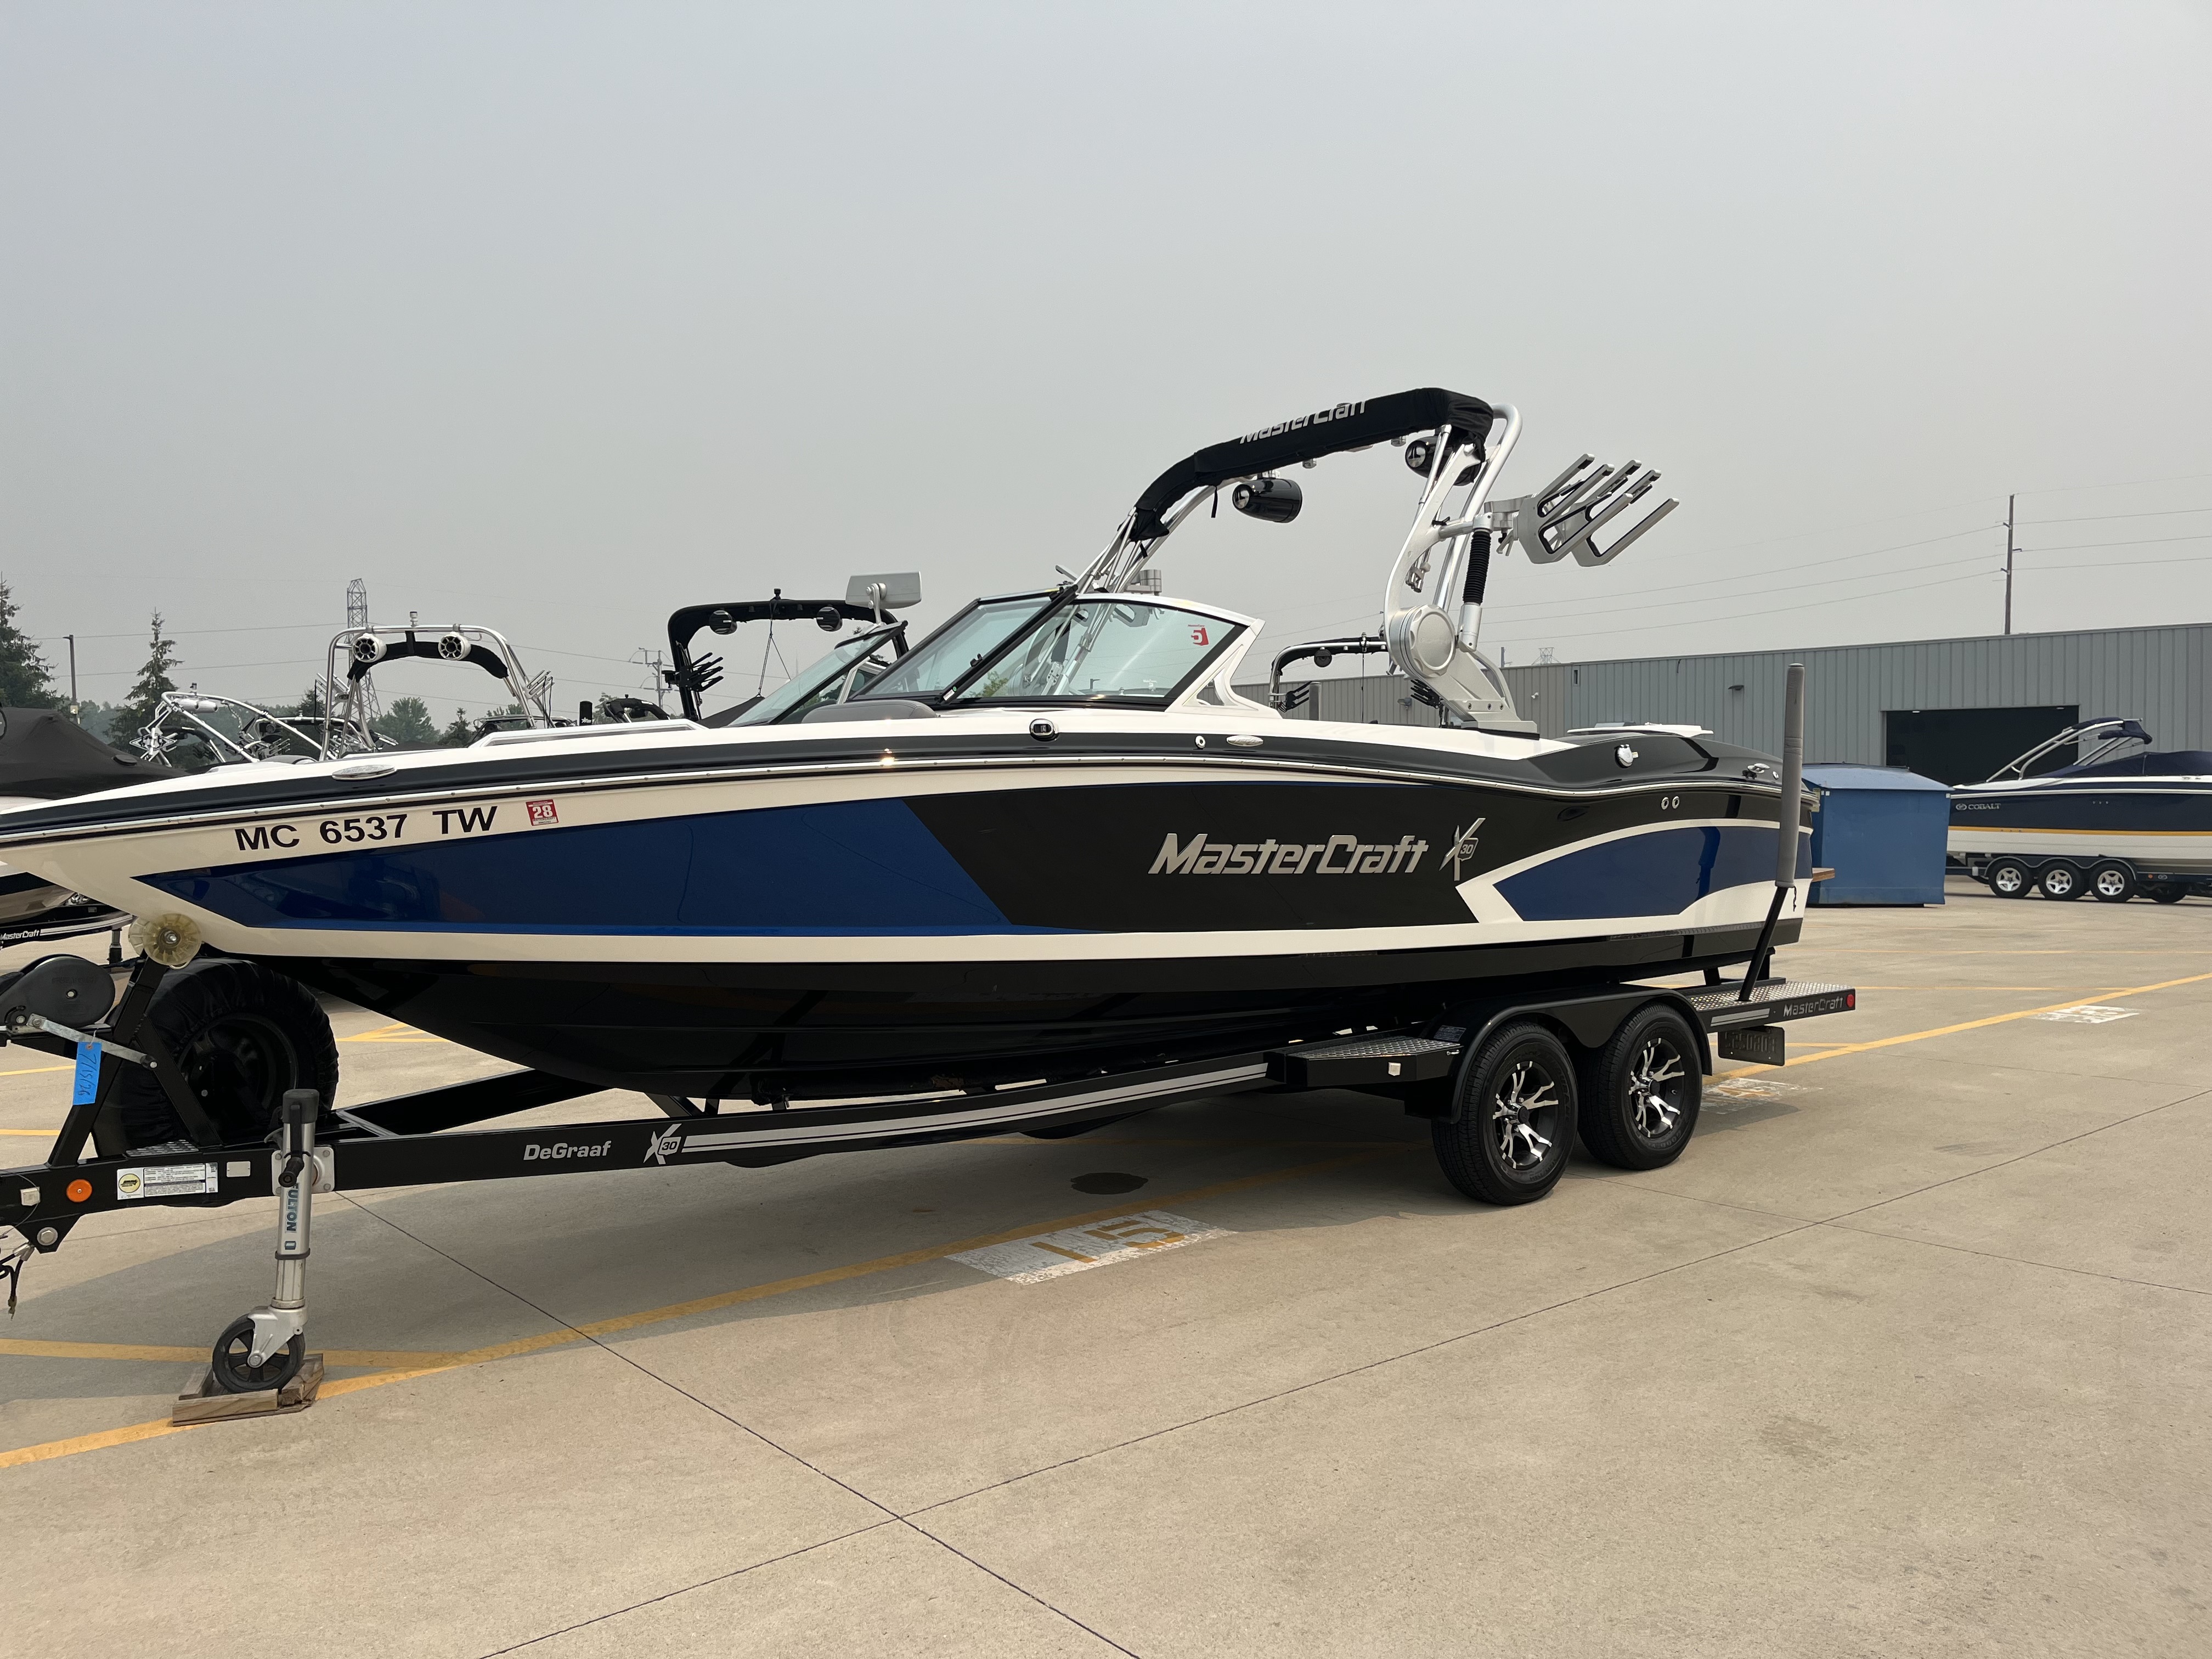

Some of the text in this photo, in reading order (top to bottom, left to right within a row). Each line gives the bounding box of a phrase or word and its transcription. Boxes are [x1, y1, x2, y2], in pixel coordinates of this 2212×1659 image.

[532, 805, 553, 819] 28
[234, 806, 498, 850] MC 6537 TW
[1148, 833, 1429, 874] MasterCraft
[0, 929, 40, 940] MasterCraft
[1783, 996, 1843, 1017] MasterCraft
[523, 1141, 612, 1160] DeGraaf
[1030, 1220, 1185, 1263] 15
